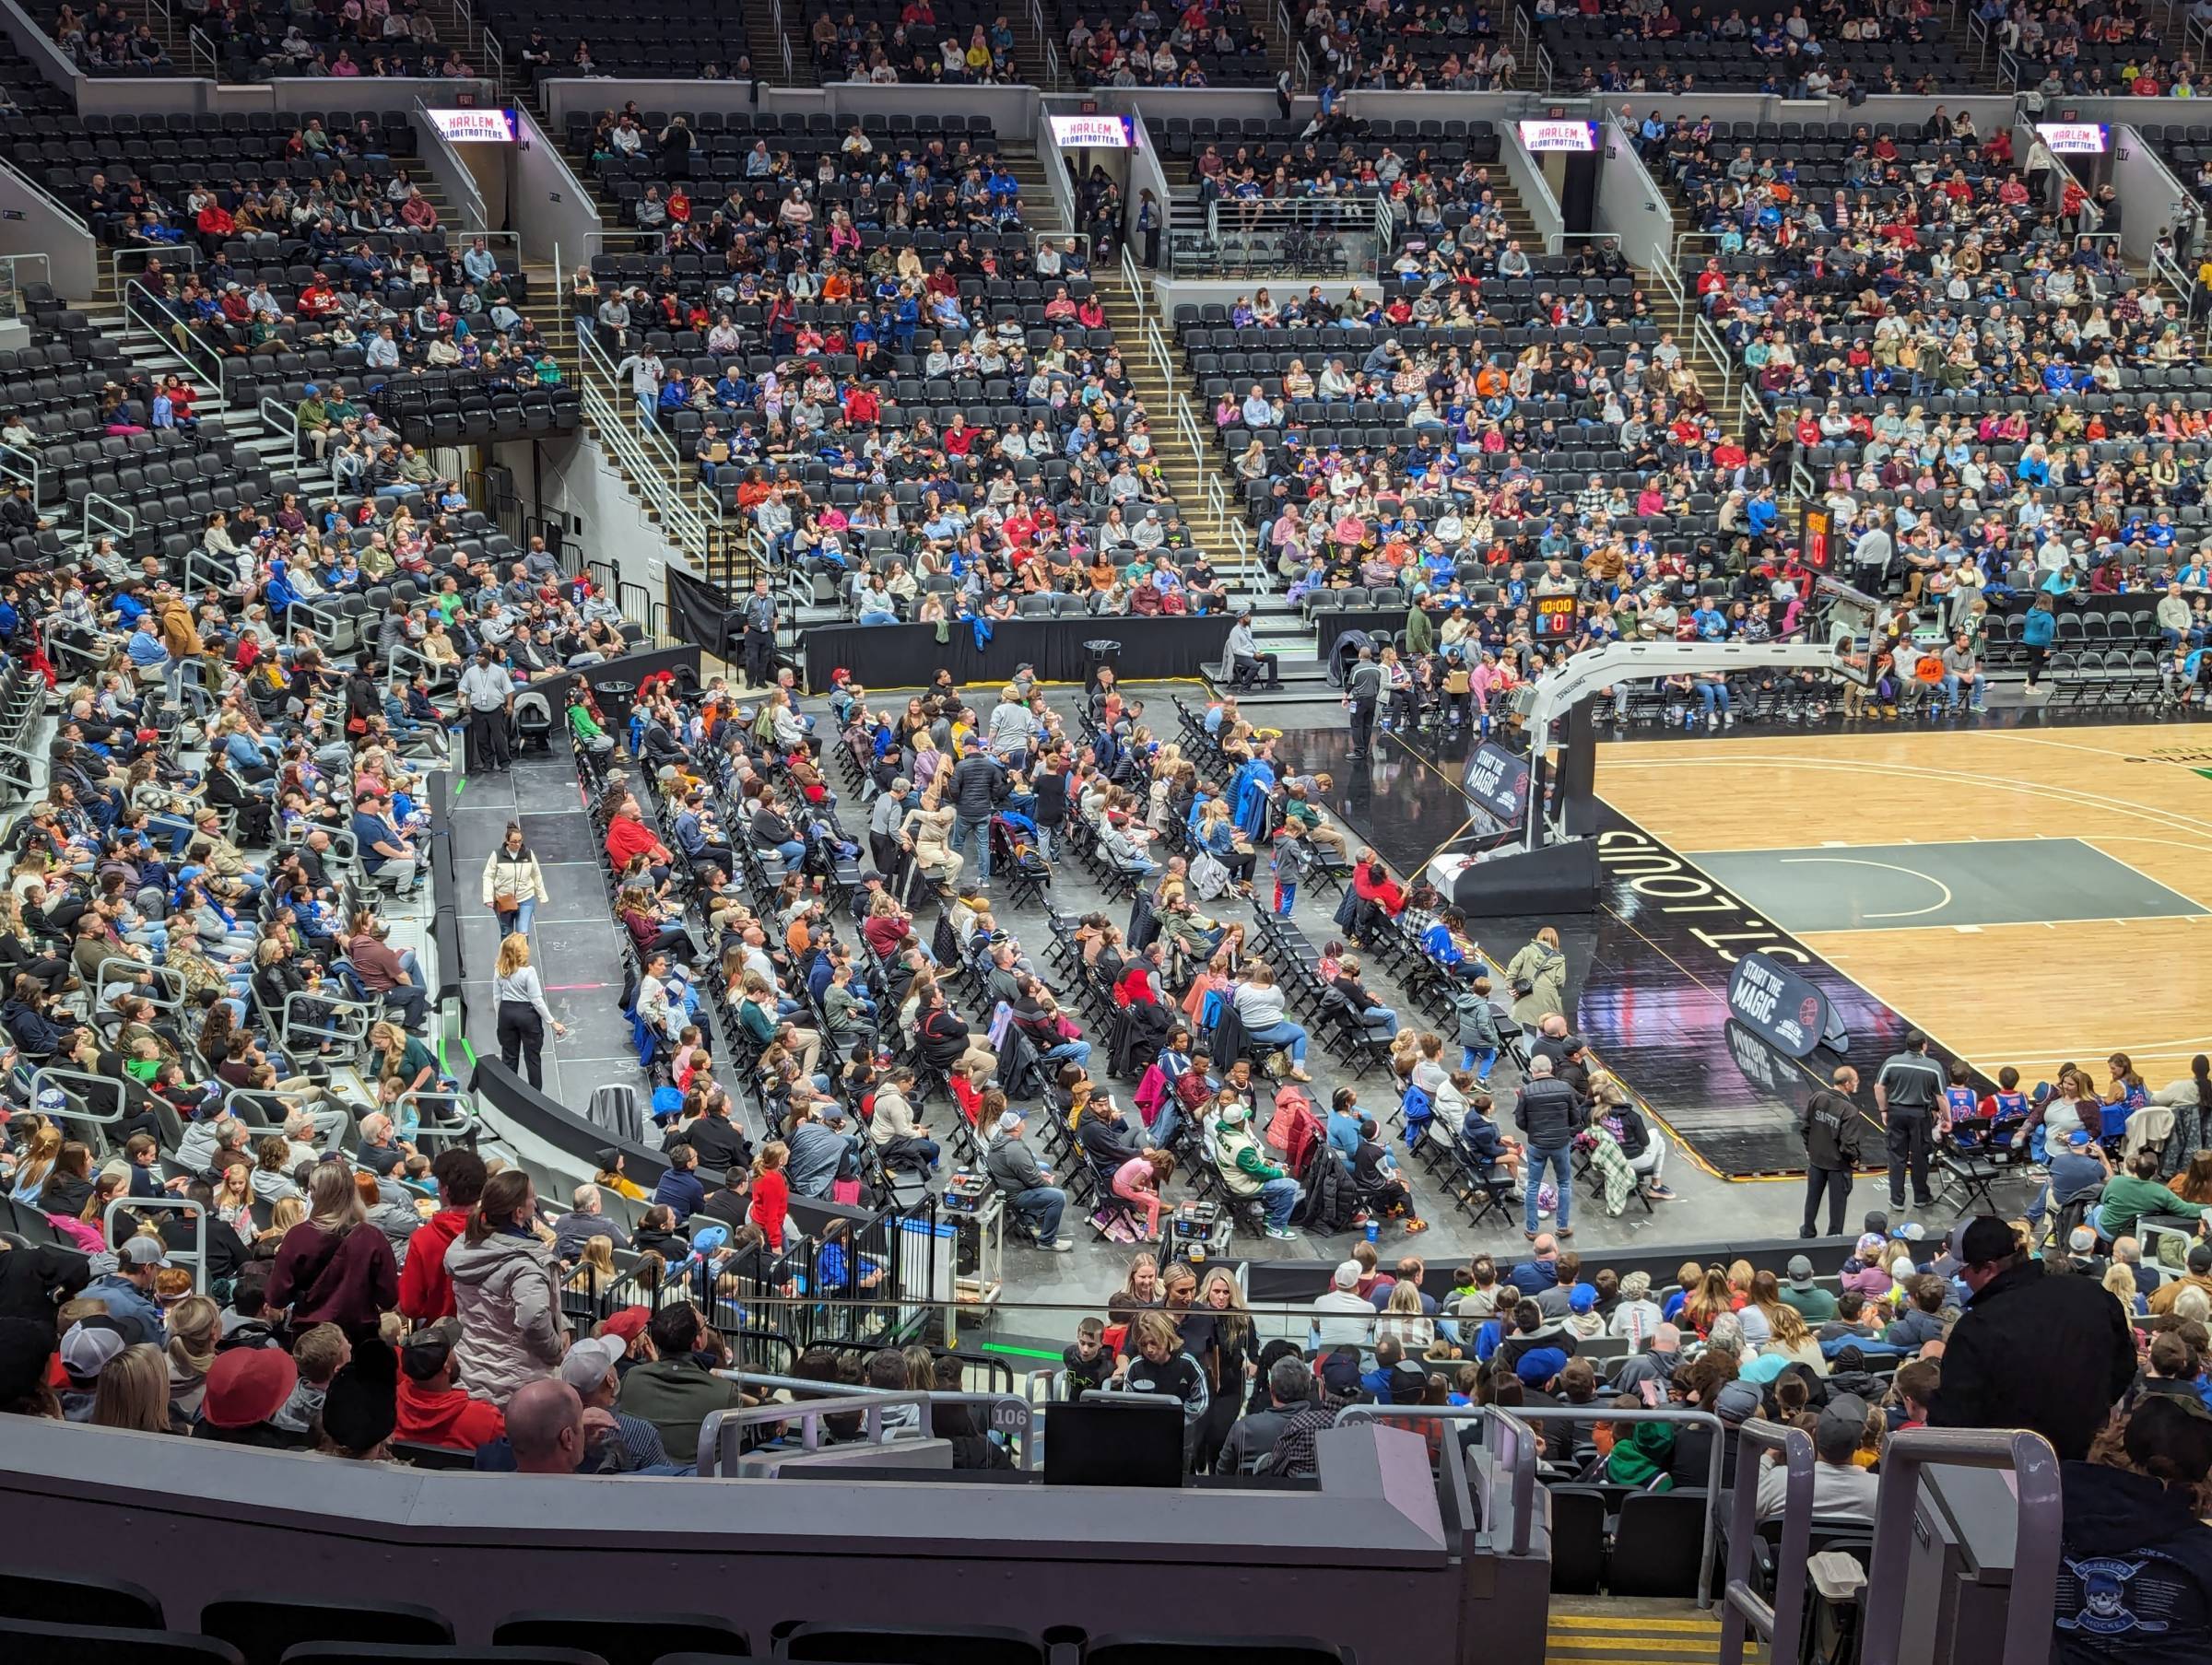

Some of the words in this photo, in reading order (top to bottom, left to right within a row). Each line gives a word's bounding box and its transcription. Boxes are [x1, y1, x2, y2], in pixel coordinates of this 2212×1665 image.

[449, 116, 494, 129] HARLEM
[1070, 123, 1112, 135] HARLEM
[1538, 127, 1578, 139] HARLEM
[2053, 130, 2090, 141] HARLEM
[1061, 135, 1120, 146] GLOBETROTTERS
[1530, 138, 1585, 149] GLOBETROTTERS
[1814, 534, 1824, 565] 0
[1540, 599, 1572, 614] 10:00
[1553, 614, 1564, 631] 0
[1466, 764, 1500, 797] MAGIC
[1742, 959, 1770, 988] START
[1766, 973, 1785, 999] THE
[1731, 978, 1778, 1025] MAGIC
[994, 1408, 1028, 1425] 106
[2085, 1619, 2126, 1631] HOCKEY
